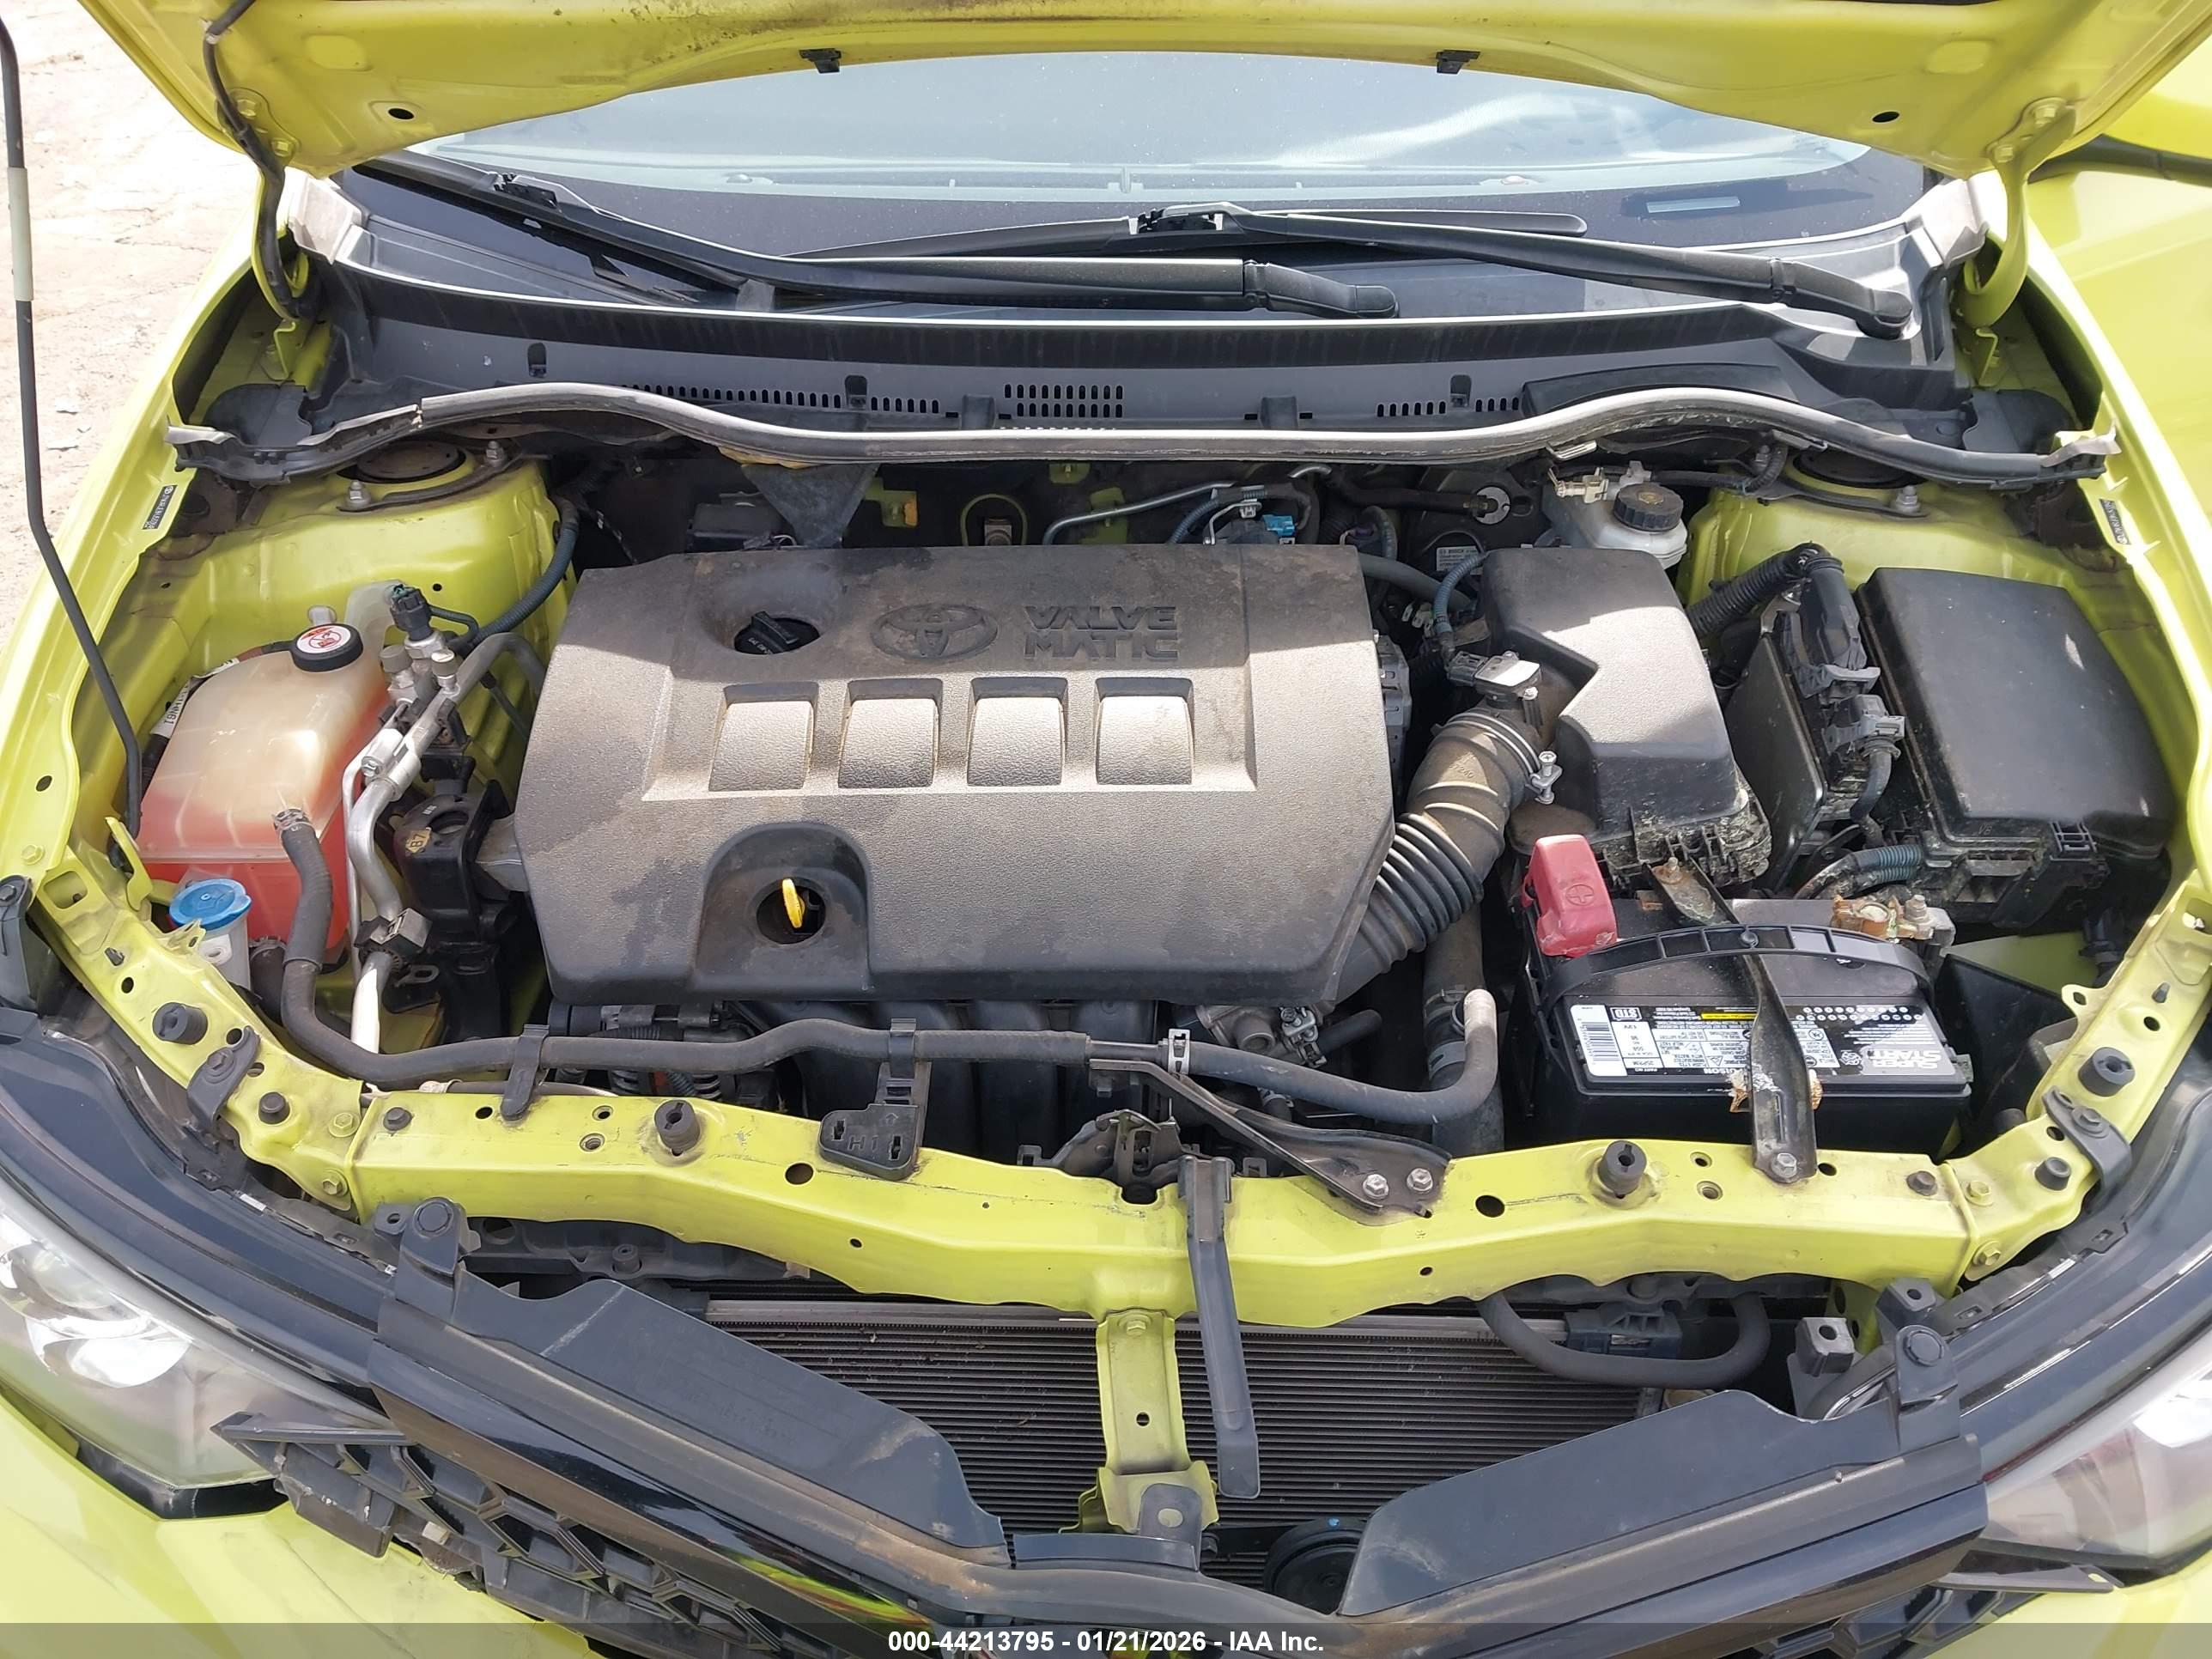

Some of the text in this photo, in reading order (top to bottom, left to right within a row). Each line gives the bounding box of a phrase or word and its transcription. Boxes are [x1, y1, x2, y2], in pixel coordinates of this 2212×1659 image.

[1024, 605, 1177, 630] VALVE
[1024, 630, 1178, 659] MATIC
[1615, 1009, 1638, 1018] STD
[1869, 1050, 1942, 1061] START
[1871, 1060, 1938, 1069] SUPER
